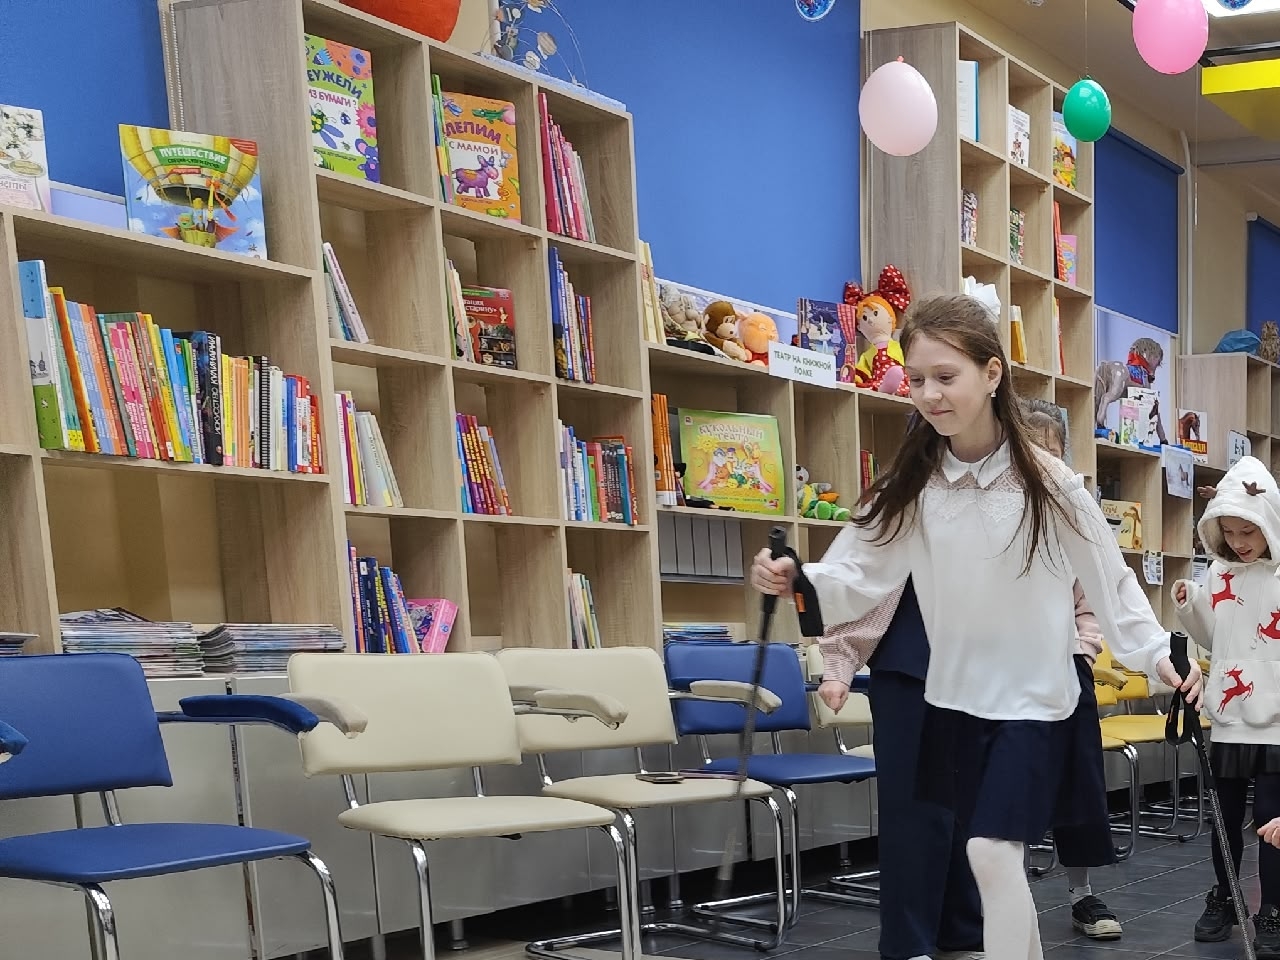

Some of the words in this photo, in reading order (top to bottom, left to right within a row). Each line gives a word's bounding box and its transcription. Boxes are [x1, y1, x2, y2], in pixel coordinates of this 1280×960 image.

[307, 69, 363, 100] ЕУЖЕЛИ
[445, 121, 501, 144] ЛЕПИМ
[159, 147, 227, 165] ПУТЕШЕСТВИЕ
[774, 351, 791, 360] ТЕАТР
[792, 355, 801, 363] НА
[803, 358, 832, 370] КНИЖНОЙ
[794, 366, 813, 377] ПОЛКЕ
[212, 386, 221, 435] ИСКУССТВО
